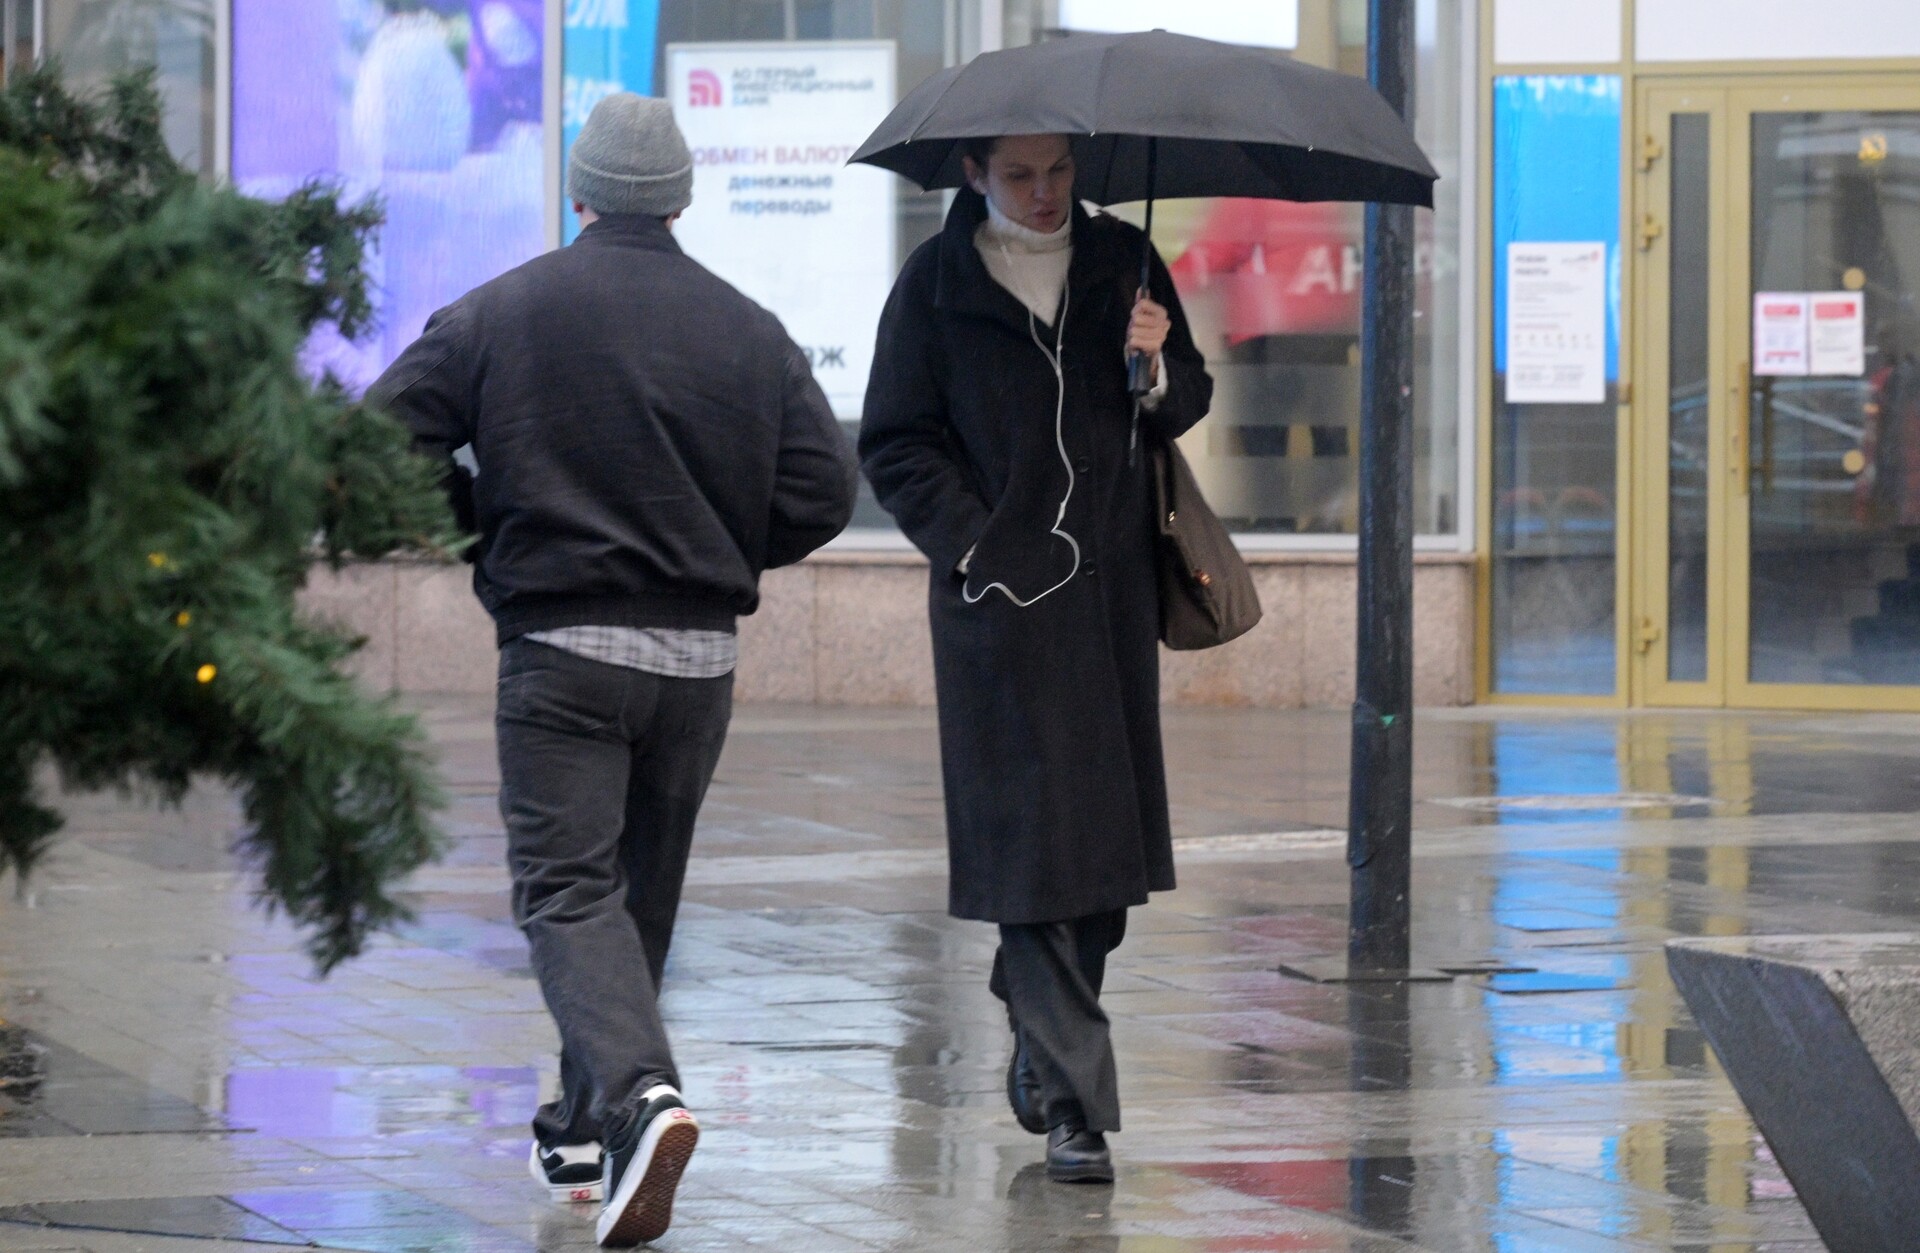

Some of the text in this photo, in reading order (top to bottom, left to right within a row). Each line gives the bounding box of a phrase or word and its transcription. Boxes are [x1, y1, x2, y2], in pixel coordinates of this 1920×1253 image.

[693, 146, 766, 165] ОБМЕН
[728, 175, 834, 193] денежные
[730, 201, 832, 217] переводы
